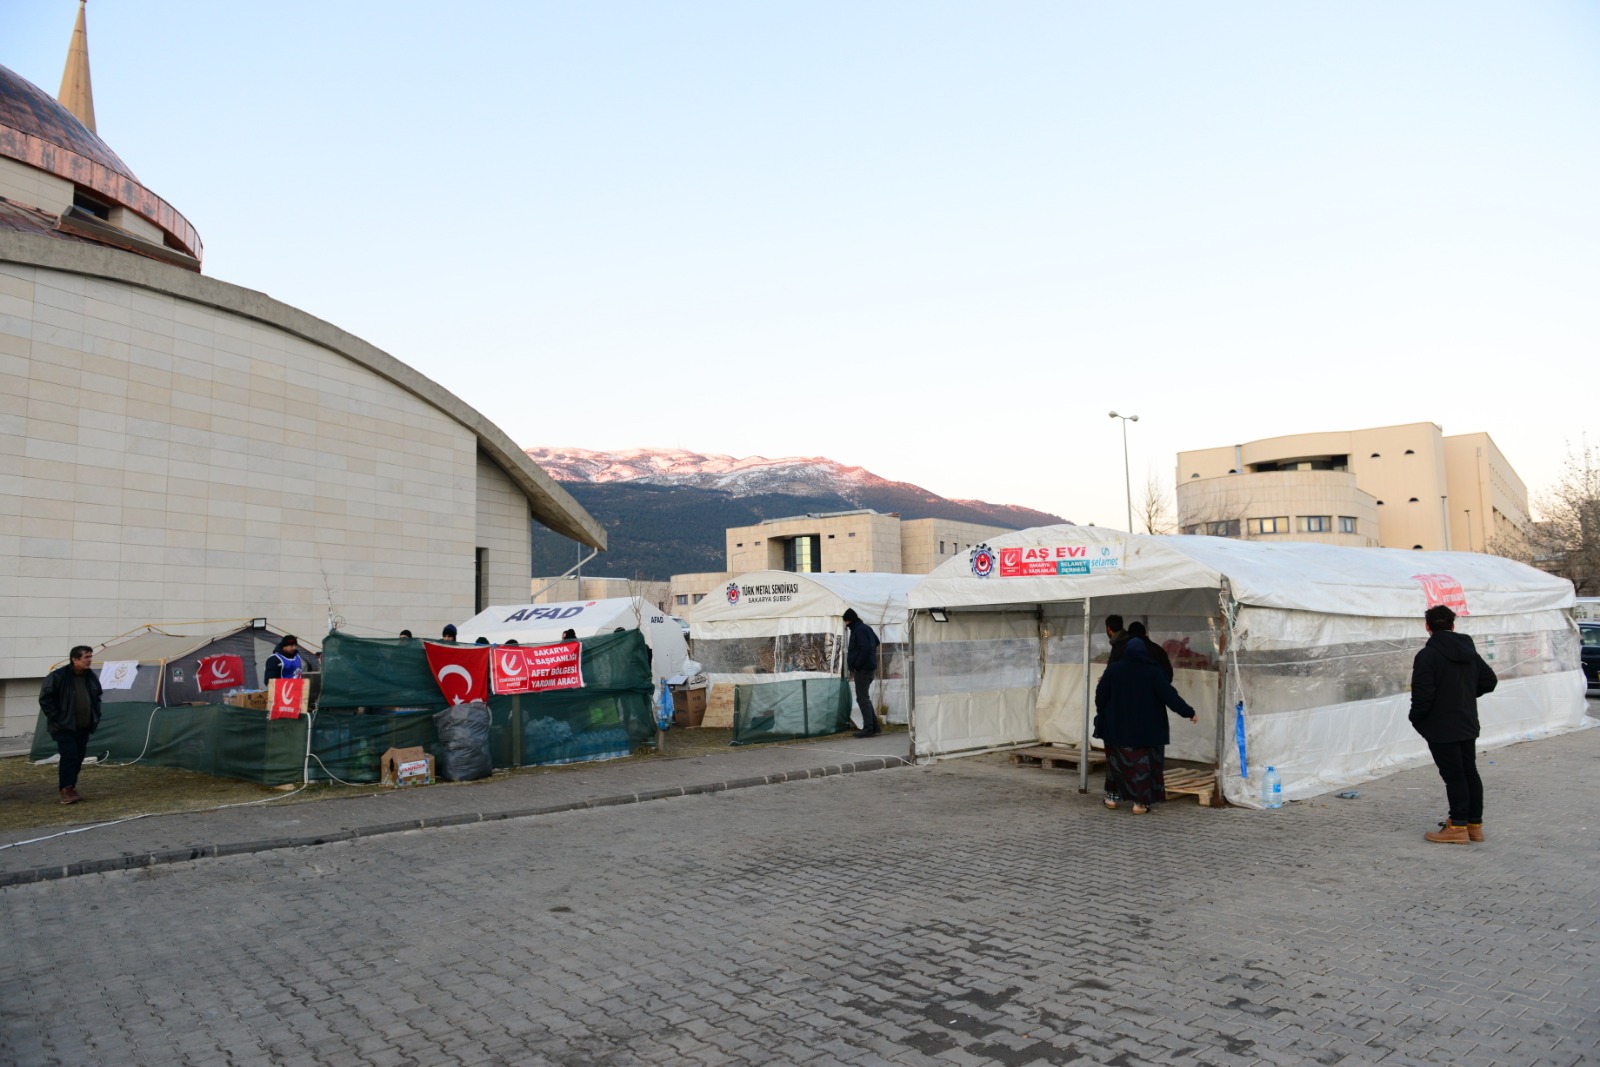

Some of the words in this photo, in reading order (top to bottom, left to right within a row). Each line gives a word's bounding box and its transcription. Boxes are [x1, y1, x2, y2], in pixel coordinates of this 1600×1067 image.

[1026, 548, 1050, 561] AŞ
[1091, 557, 1118, 567] selamet
[742, 585, 755, 596] TÜRK
[755, 584, 771, 595] METAL
[771, 582, 799, 595] SENDİKASI
[502, 606, 585, 623] AFAD
[650, 616, 664, 624] AFAD
[533, 646, 569, 657] SAKARYA
[536, 653, 577, 665] BAŞKANLIĞI
[531, 668, 550, 678] AFET
[551, 664, 577, 676] BÖLGESİ
[531, 678, 556, 688] YARDIM
[557, 676, 578, 685] ARACI
